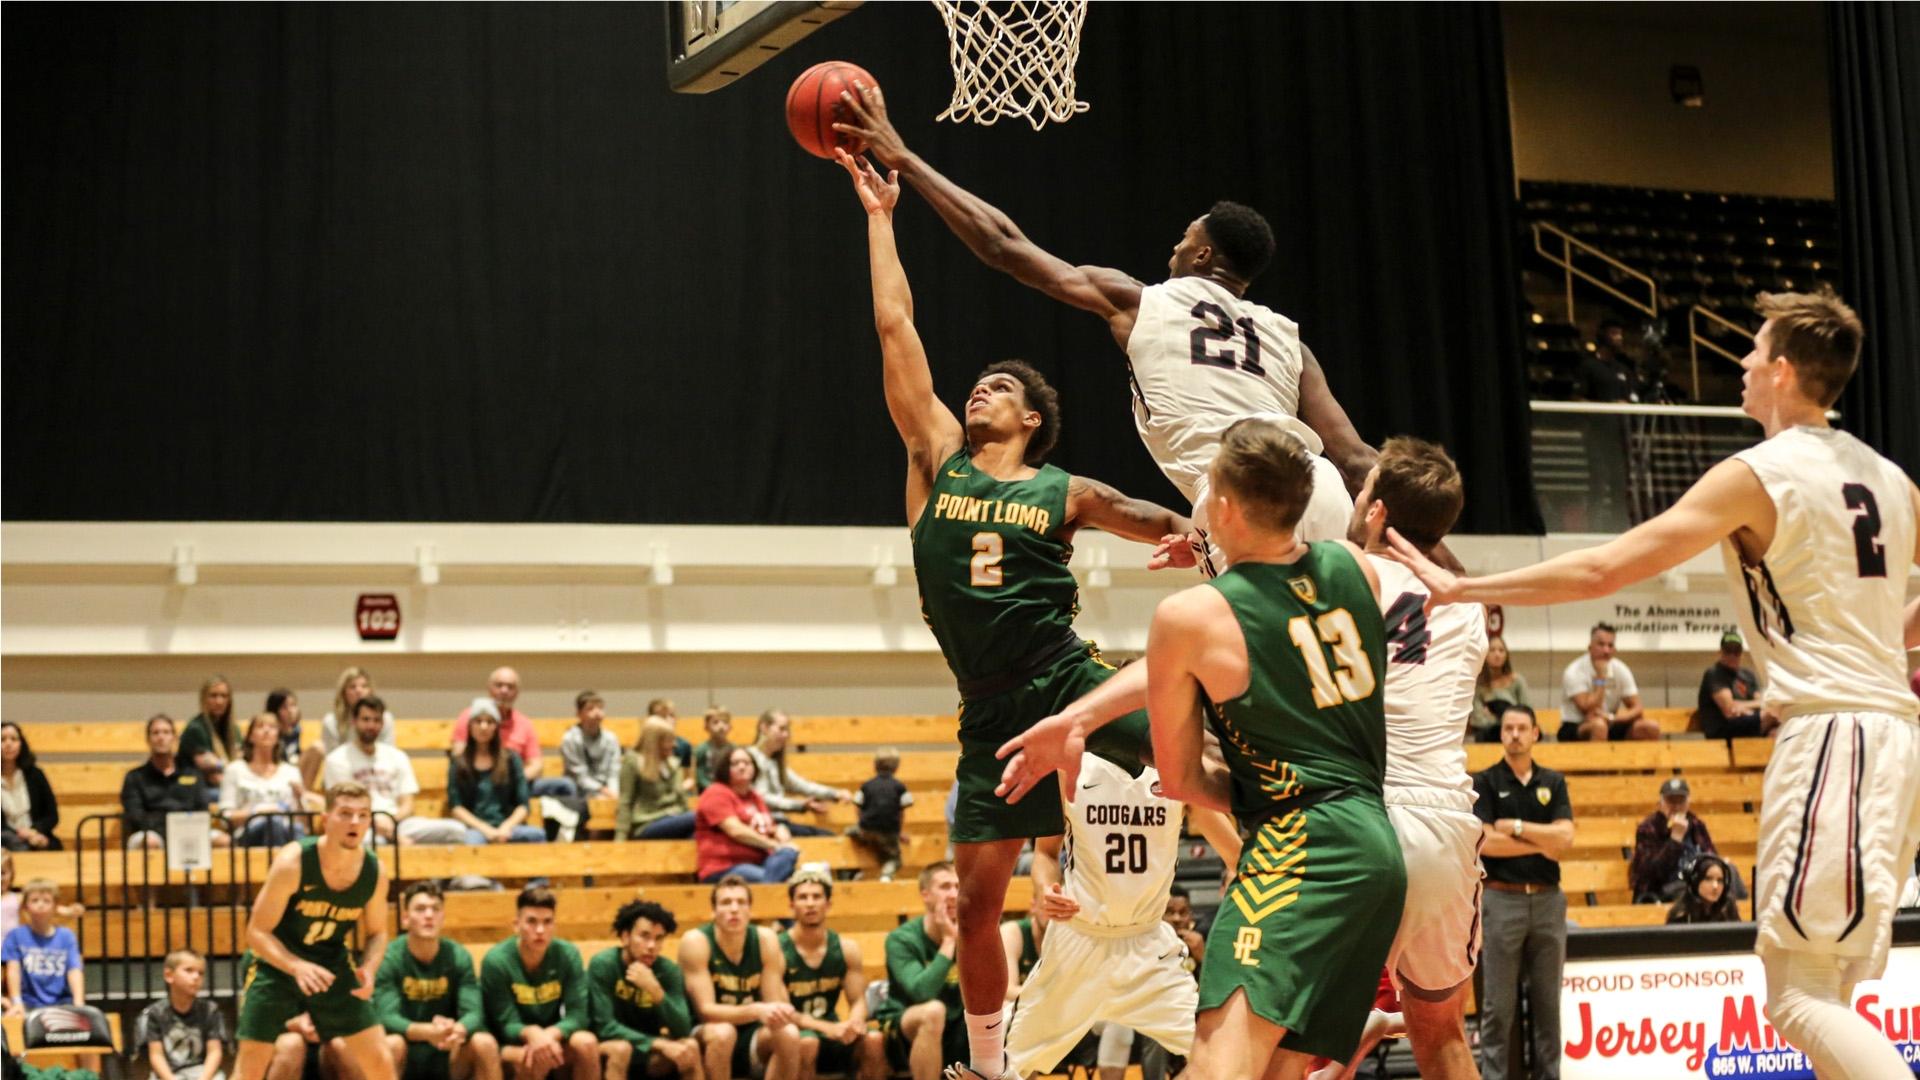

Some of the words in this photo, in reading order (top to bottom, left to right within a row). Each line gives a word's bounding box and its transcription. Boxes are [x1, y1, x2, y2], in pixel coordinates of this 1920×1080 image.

[1190, 300, 1266, 378] 21
[935, 492, 993, 522] POINT
[993, 500, 1050, 535] LOMA
[1842, 482, 1887, 578] 2
[971, 531, 1003, 587] 2
[360, 610, 397, 630] 102
[1615, 605, 1641, 616] The
[1646, 605, 1720, 617] Ahmanson
[1288, 607, 1376, 710] 13
[1086, 804, 1167, 827] COUGARS
[1105, 832, 1148, 874] 20
[1561, 975, 1634, 993] PROUD
[1640, 970, 1744, 990] SPONSOR
[1564, 1002, 1706, 1072] Jersey
[1737, 1055, 1754, 1075] W.
[1756, 1052, 1803, 1073] ROUTE
